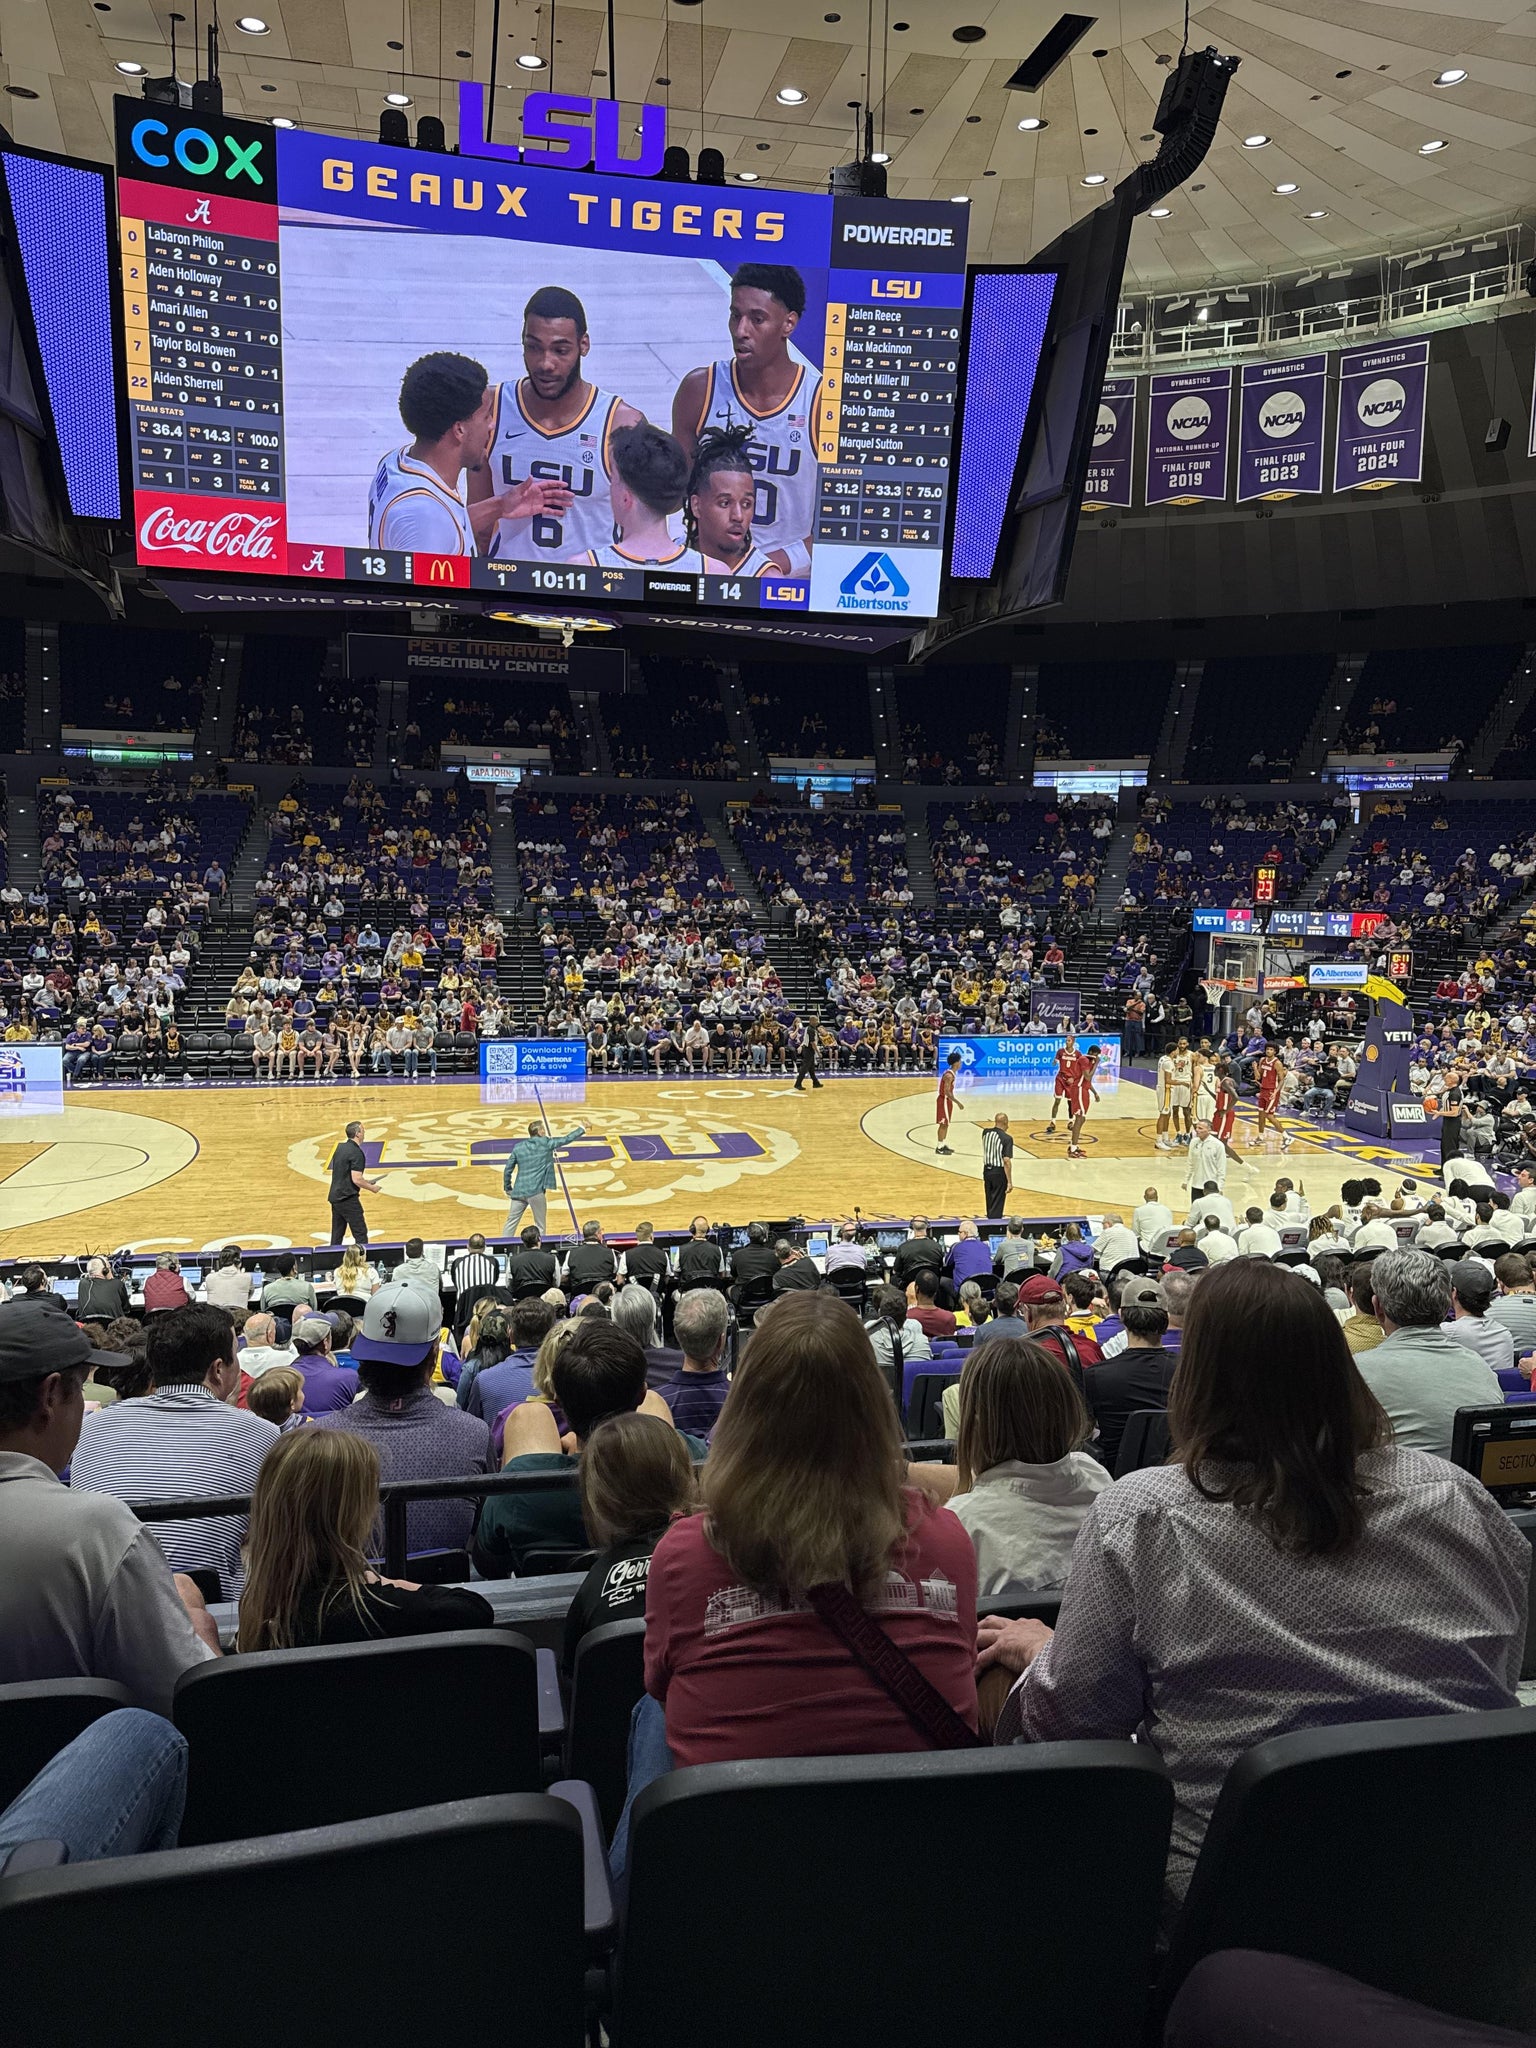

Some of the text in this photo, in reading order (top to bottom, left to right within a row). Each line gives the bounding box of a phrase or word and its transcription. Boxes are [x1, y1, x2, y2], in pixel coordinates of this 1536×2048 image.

[459, 80, 666, 177] LSU
[131, 118, 264, 185] COX
[322, 158, 785, 242] GEAUX TIGERS
[128, 231, 137, 241] 0
[148, 227, 224, 251] Labaron Philon
[843, 224, 955, 246] POWERADE
[130, 267, 139, 278] 2
[148, 263, 222, 287] Aden Holloway
[871, 279, 922, 299] LSU
[132, 304, 140, 315] 5
[150, 300, 208, 319] Amari Allen
[849, 309, 901, 322] Jalen Reece
[832, 314, 839, 324] 2
[134, 341, 141, 351] 7
[151, 335, 236, 357] Taylor Bol Bowen
[830, 347, 837, 356] 3
[846, 341, 912, 354] Max Mackinnon
[1363, 352, 1406, 368] GYMNASTICS
[1263, 363, 1305, 376] GYMNASTICS
[131, 376, 147, 388] 22
[153, 371, 223, 391] Aiden Sherrell
[828, 379, 835, 388] 6
[844, 373, 910, 386] Robert Miller III
[1170, 376, 1211, 388] GYMNASTICS
[136, 404, 184, 416] TEAM STATS
[842, 405, 895, 418] Pablo Tamba
[1363, 400, 1403, 417] NCAA
[826, 411, 833, 420] 8
[1263, 411, 1303, 428] NCAA
[1172, 415, 1209, 431] NCAA
[153, 423, 183, 437] 36.4
[203, 429, 231, 442] 14.3
[250, 434, 278, 447] 100.0
[840, 436, 903, 450] Marquel Sutton
[821, 443, 834, 452] 10
[1155, 441, 1220, 453] NATIONAL RUNNER-UP
[1352, 439, 1405, 455] FINAL FOUR
[164, 448, 172, 459] 7
[213, 454, 222, 464] 2
[740, 442, 801, 476] SU
[1254, 452, 1306, 467] FINAL FOUR
[260, 458, 269, 469] 2
[1162, 460, 1211, 473] FINAL FOUR
[1357, 452, 1399, 472] 2024
[166, 472, 172, 483] 1
[502, 454, 594, 497] LSU
[843, 468, 862, 476] STATS
[1101, 468, 1115, 476] SIX
[1260, 465, 1299, 483] 2023
[214, 477, 223, 488] 3
[1085, 480, 1109, 493] 018
[1169, 473, 1202, 488] 2019
[261, 482, 270, 492] 4
[835, 483, 859, 495] 31.2
[876, 486, 901, 497] 33.3
[917, 486, 942, 498] 75.0
[840, 505, 851, 515] 11
[882, 507, 890, 517] 2
[924, 509, 931, 519] 2
[532, 503, 562, 548] 6
[841, 527, 847, 536] 1
[141, 506, 281, 559] Coca-Cola
[881, 529, 888, 538] 3
[922, 530, 930, 540] 4
[362, 557, 386, 575] 13
[487, 562, 517, 572] PERIOD
[498, 573, 505, 585] 1
[532, 570, 587, 592] 10:11
[602, 571, 625, 580] POSS.
[649, 581, 691, 592] POWERADE
[719, 583, 741, 600] 14
[766, 586, 804, 602] LSU
[194, 594, 459, 609] VENTURE GLOBAL
[837, 595, 910, 611] Albertsons
[408, 639, 569, 660] PETE MARAVICH
[408, 655, 569, 674] ASSEMBLY CENTER
[471, 768, 490, 776] PAPA
[1257, 881, 1272, 899] 23
[1196, 916, 1224, 925] YETI
[1274, 913, 1303, 923] 10:11
[1313, 917, 1319, 925] 4
[1230, 921, 1245, 931] 13
[1332, 924, 1348, 935] 14
[1392, 963, 1406, 974] 23
[1385, 1032, 1412, 1041] YETI
[521, 1046, 560, 1054] Download
[998, 1040, 1080, 1053] Shop onlie
[1009, 1055, 1039, 1066] pickup
[0, 1067, 25, 1079] SU
[1207, 1074, 1213, 1083] 3
[657, 1088, 808, 1100] COX
[1396, 1108, 1424, 1120] MMR
[324, 1132, 769, 1172] LSU
[610, 1560, 652, 1588] Gerr
